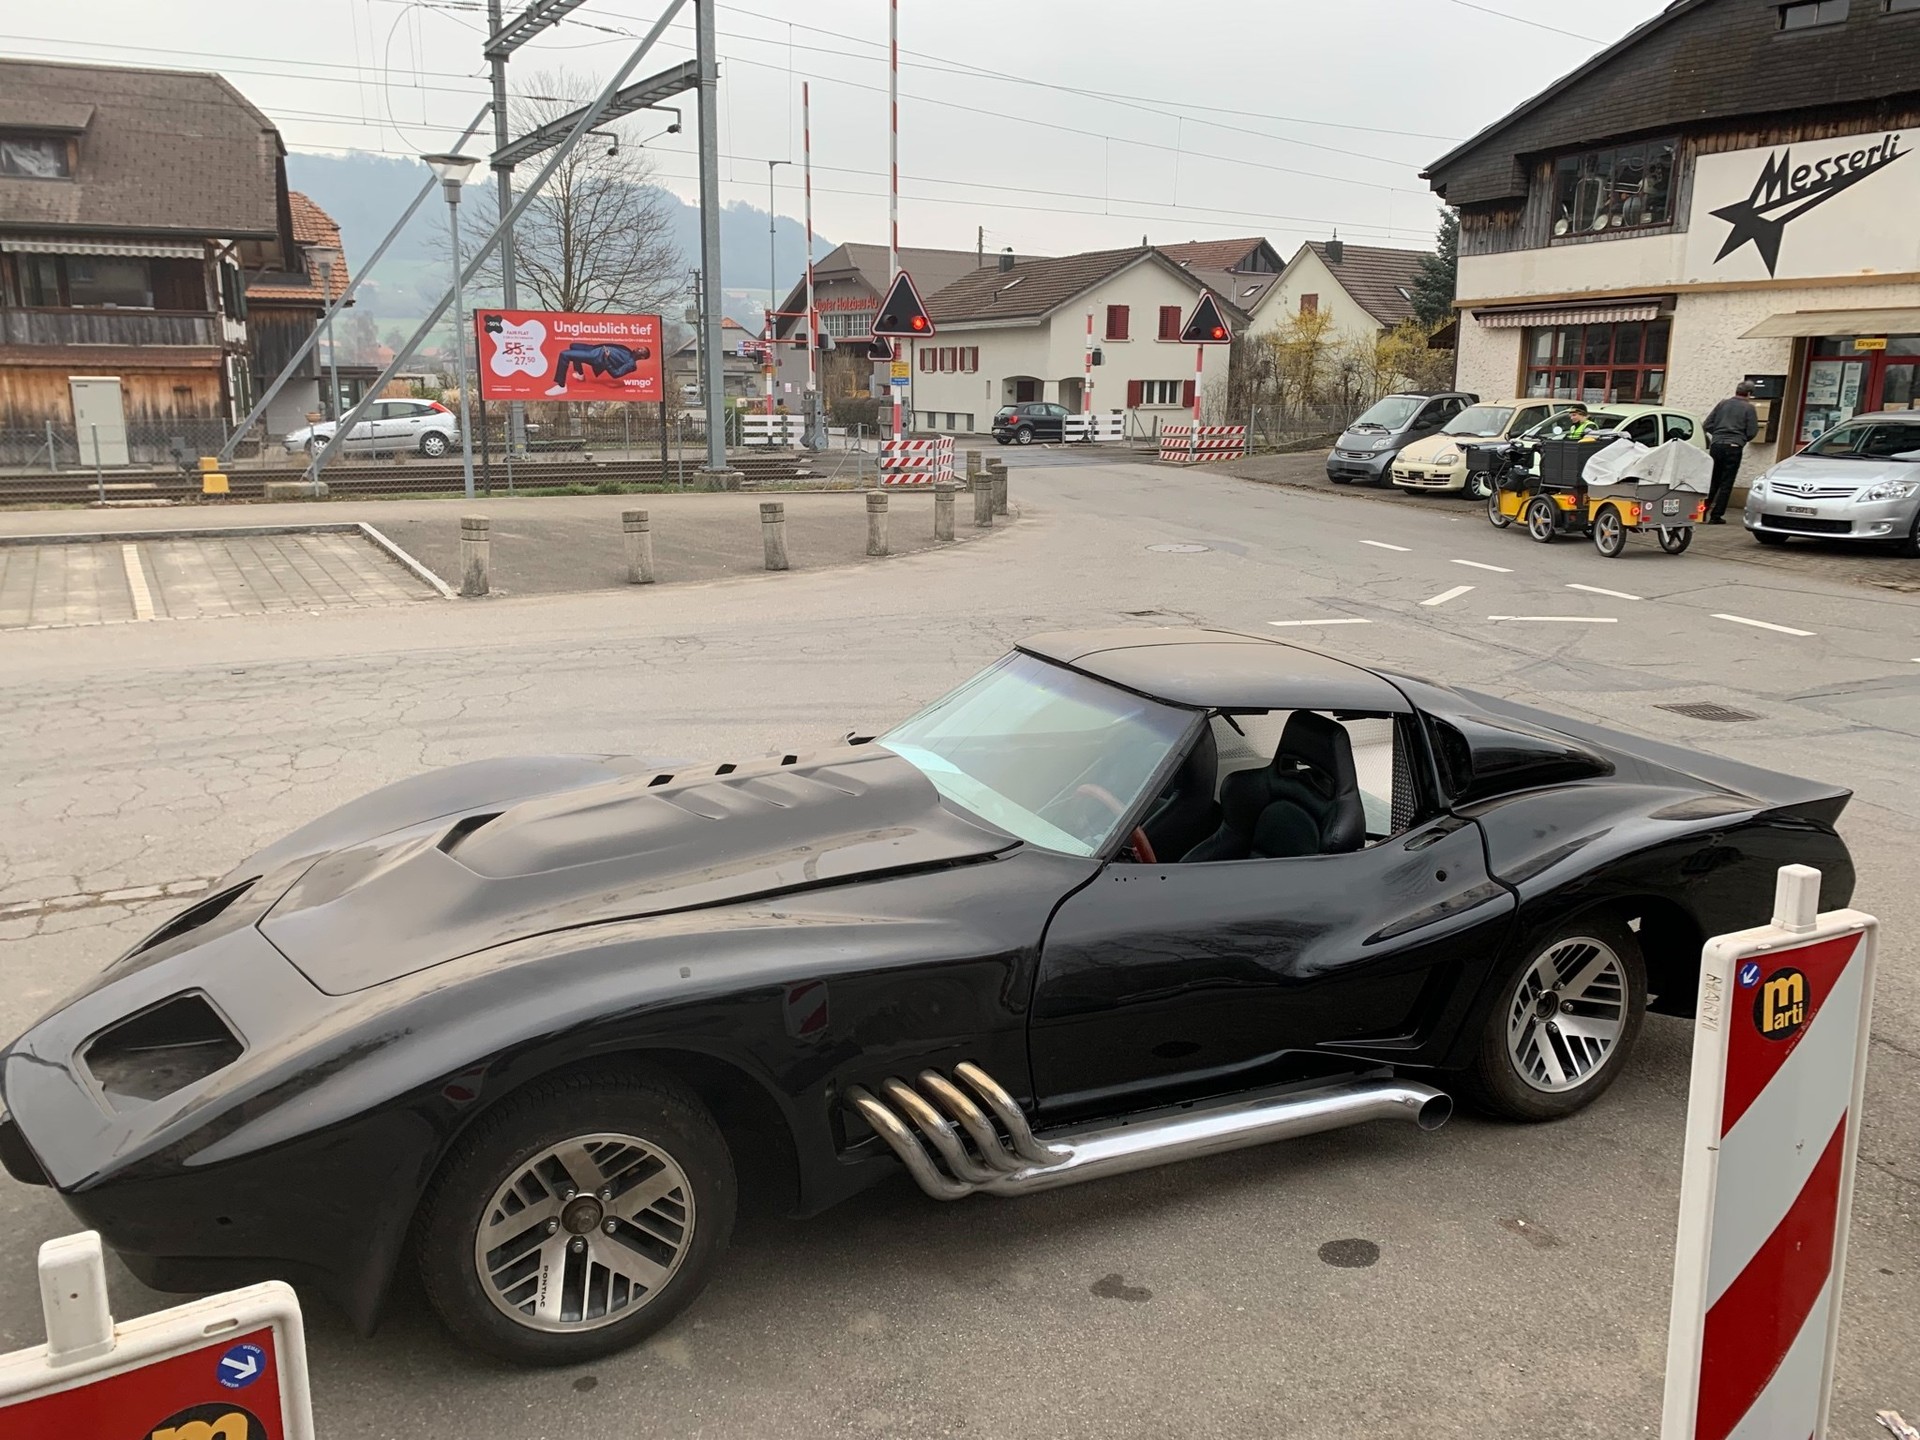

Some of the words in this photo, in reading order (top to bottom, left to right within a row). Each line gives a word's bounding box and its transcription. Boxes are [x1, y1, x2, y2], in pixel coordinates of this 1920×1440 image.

[1749, 134, 1900, 207] Messerli
[837, 296, 866, 311] Holzbau
[553, 320, 629, 336] Unglaublich
[630, 323, 653, 335] tief
[1857, 340, 1884, 348] Eingang
[623, 379, 652, 388] wingo
[540, 1265, 549, 1307] PONTIAC
[242, 1345, 261, 1354] WEMAS
